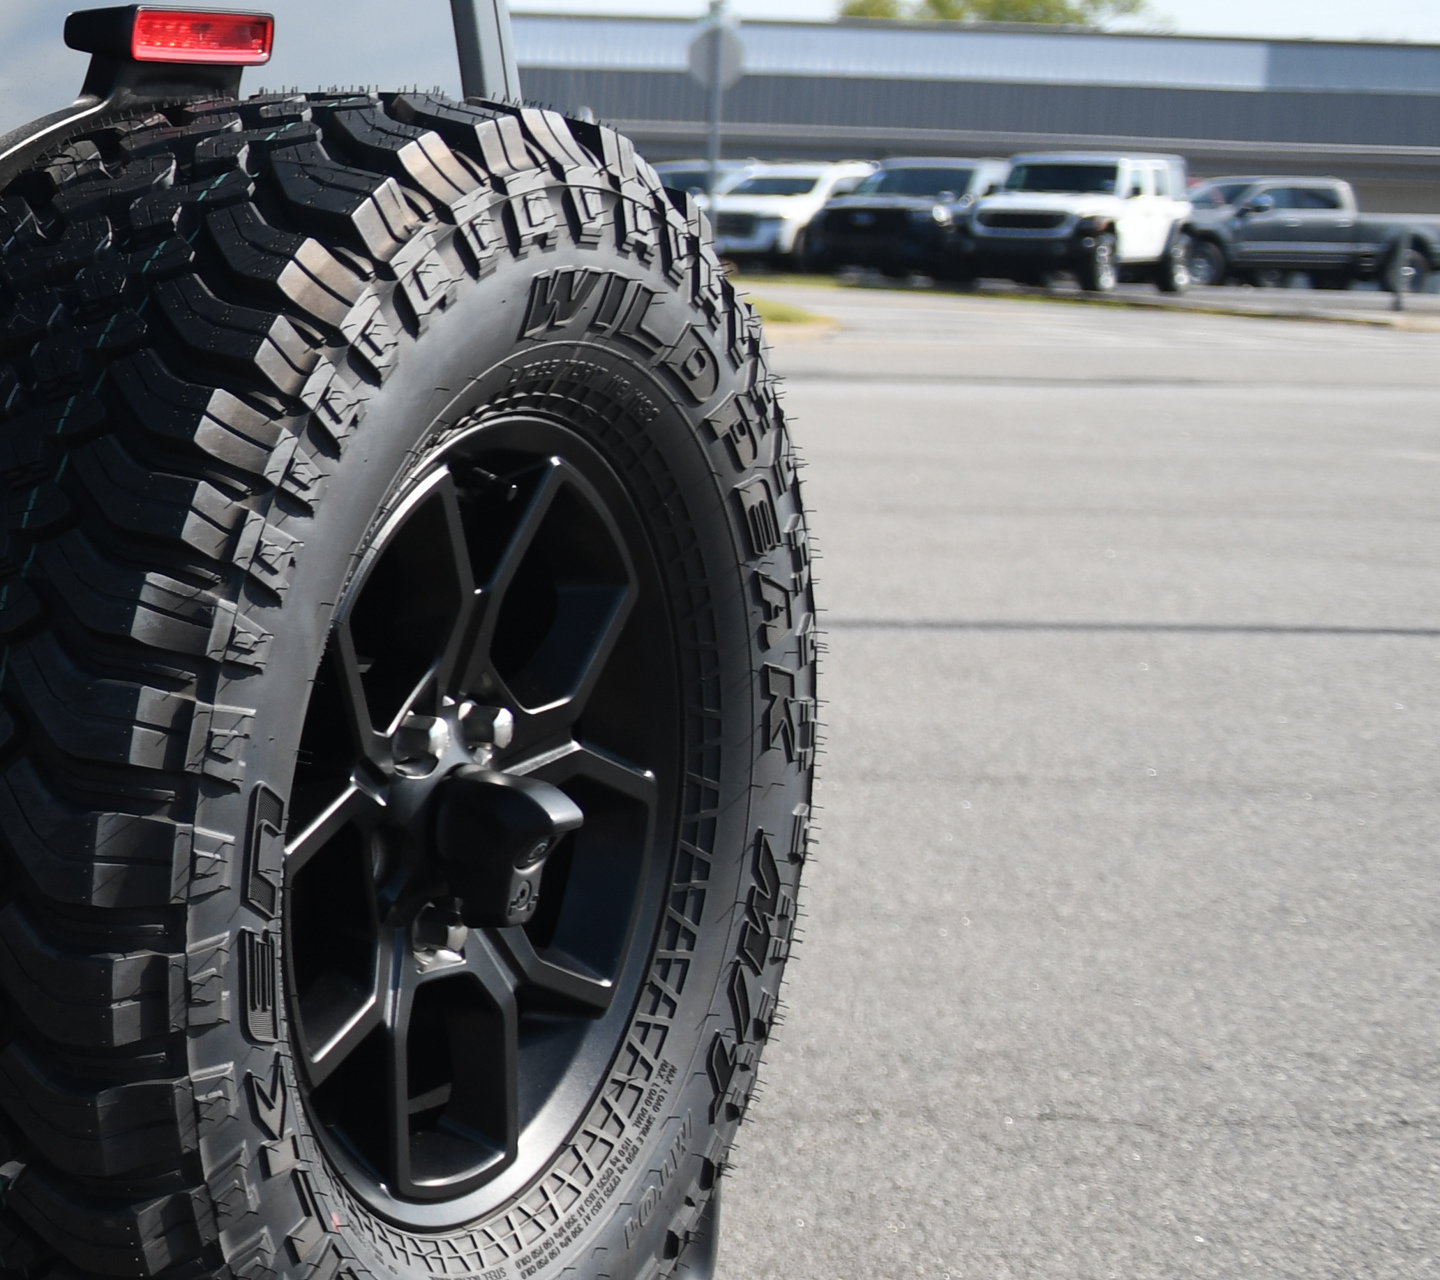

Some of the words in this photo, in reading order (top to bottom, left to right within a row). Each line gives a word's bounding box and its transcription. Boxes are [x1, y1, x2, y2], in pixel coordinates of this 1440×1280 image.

[519, 268, 796, 765] WILDPEAK
[644, 1081, 660, 1106] LOAD
[651, 1087, 668, 1113] LOAD
